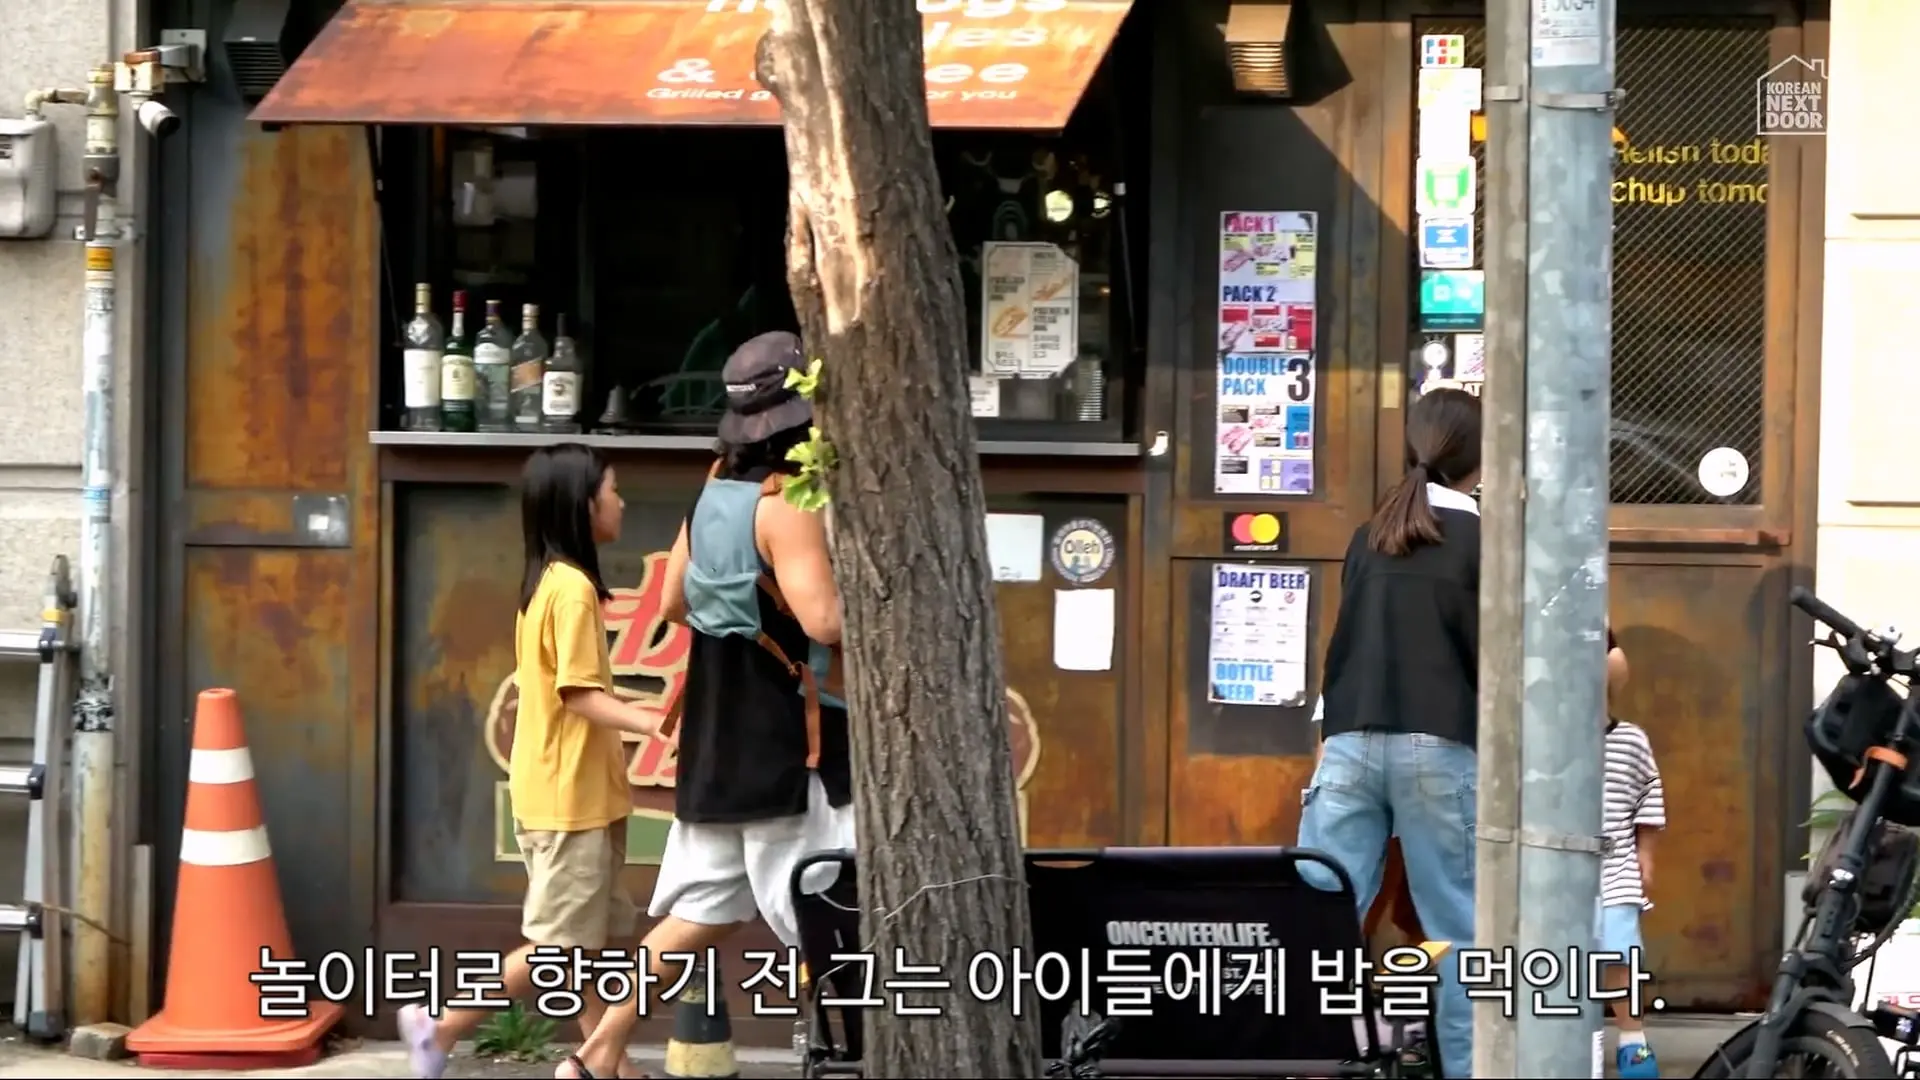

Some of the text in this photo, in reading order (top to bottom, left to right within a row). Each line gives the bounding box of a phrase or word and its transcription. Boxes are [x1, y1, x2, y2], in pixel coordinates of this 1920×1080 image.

[657, 57, 715, 82] &
[646, 87, 744, 100] Grilled
[960, 89, 1017, 104] you
[1223, 286, 1277, 301] PACK 2
[1222, 378, 1266, 395] PACK
[1223, 357, 1311, 401] DOUBLE 3
[1218, 572, 1306, 589] DRAFT BEER
[1216, 663, 1274, 681] BOTTLE
[1214, 684, 1255, 701] BEER
[1106, 920, 1280, 946] ONCEWEEKLIFE.
